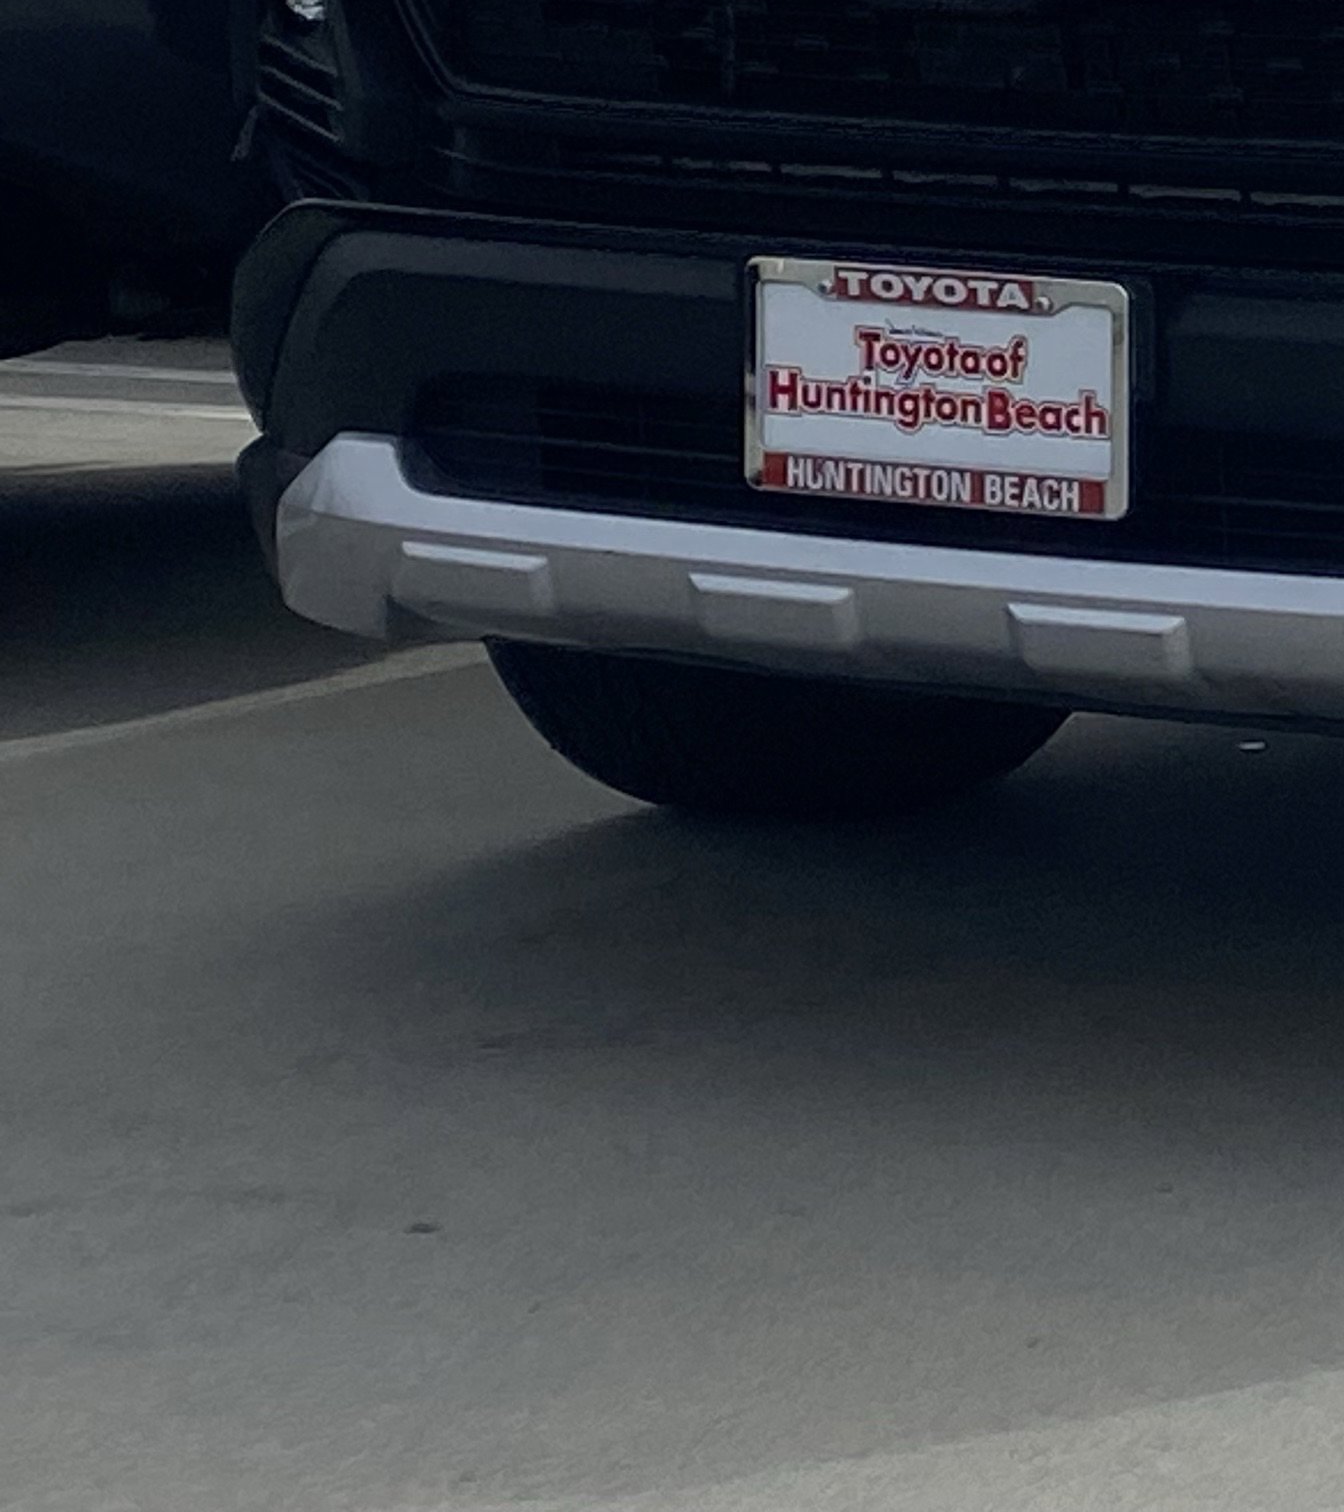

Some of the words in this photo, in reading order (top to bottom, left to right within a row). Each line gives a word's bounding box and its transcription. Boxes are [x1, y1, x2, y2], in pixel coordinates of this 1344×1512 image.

[836, 270, 1030, 310] TOYOTA
[856, 327, 982, 384] Toyota
[984, 335, 1027, 382] of
[766, 367, 984, 432] Huntington
[984, 387, 1110, 437] Beach
[786, 454, 972, 504] HUNTINGTON
[983, 472, 1081, 513] BEACH
